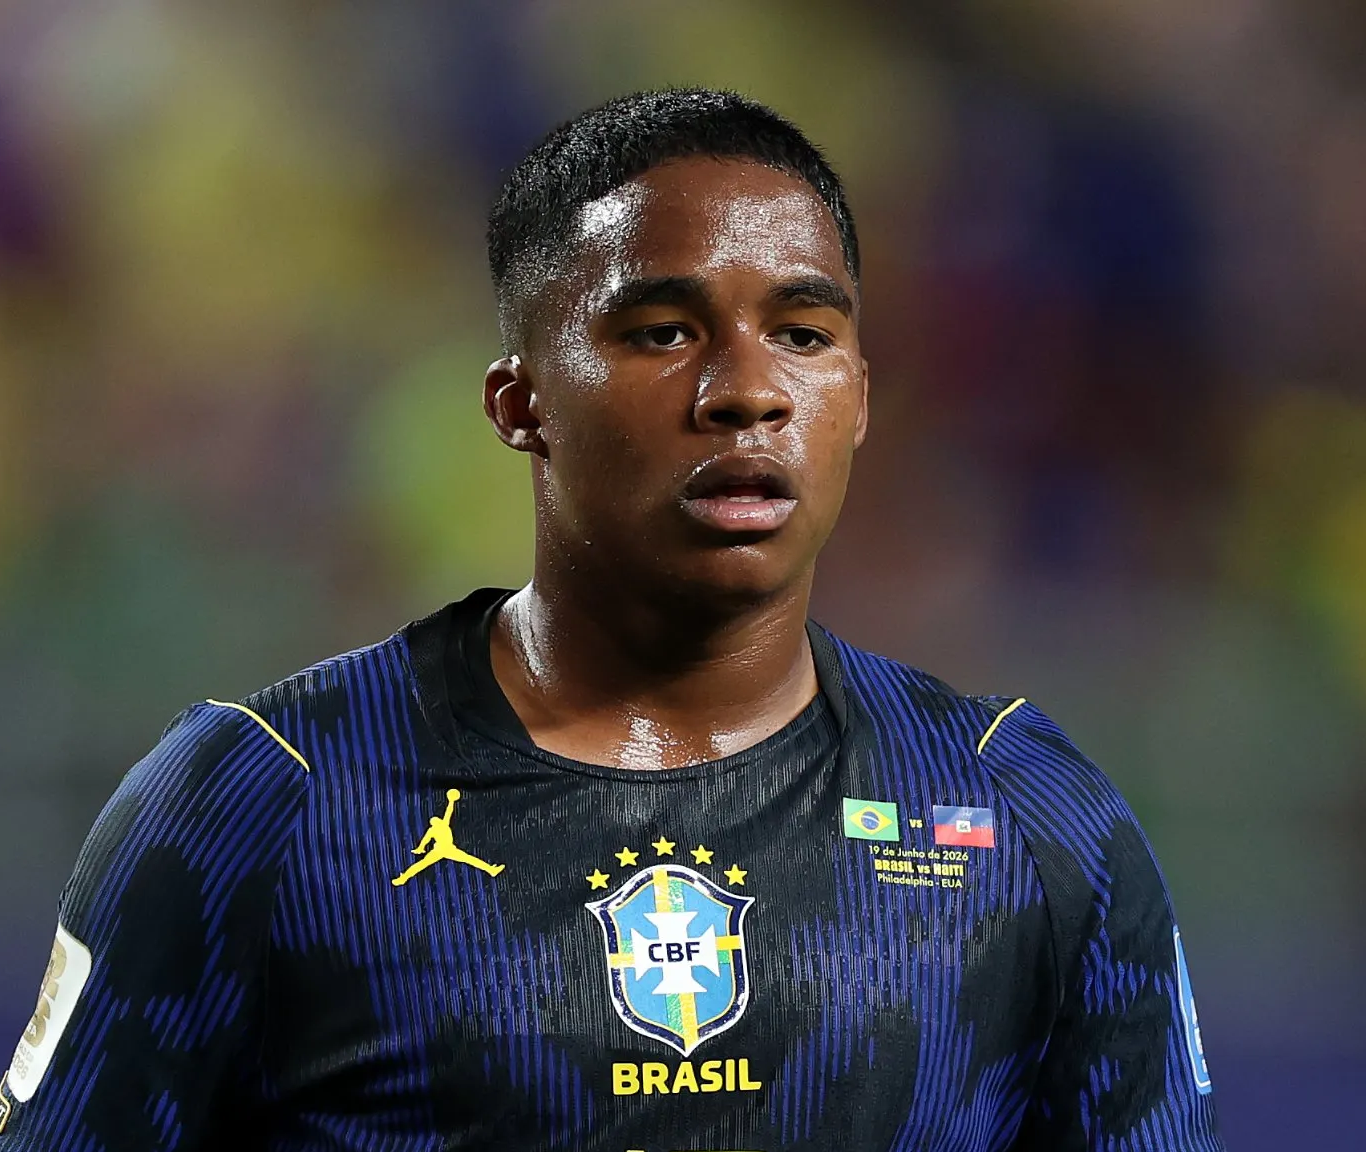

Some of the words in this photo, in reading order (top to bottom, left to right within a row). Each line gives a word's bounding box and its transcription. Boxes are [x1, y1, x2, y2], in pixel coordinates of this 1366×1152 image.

[909, 818, 923, 829] vs
[868, 845, 880, 855] 19
[882, 846, 895, 856] de
[897, 847, 925, 859] Junho
[927, 848, 941, 860] de
[942, 850, 969, 861] 2026
[877, 872, 934, 888] Philadelphia
[941, 878, 963, 888] EUA
[648, 941, 701, 964] CBF
[612, 1058, 762, 1096] BRASIL
